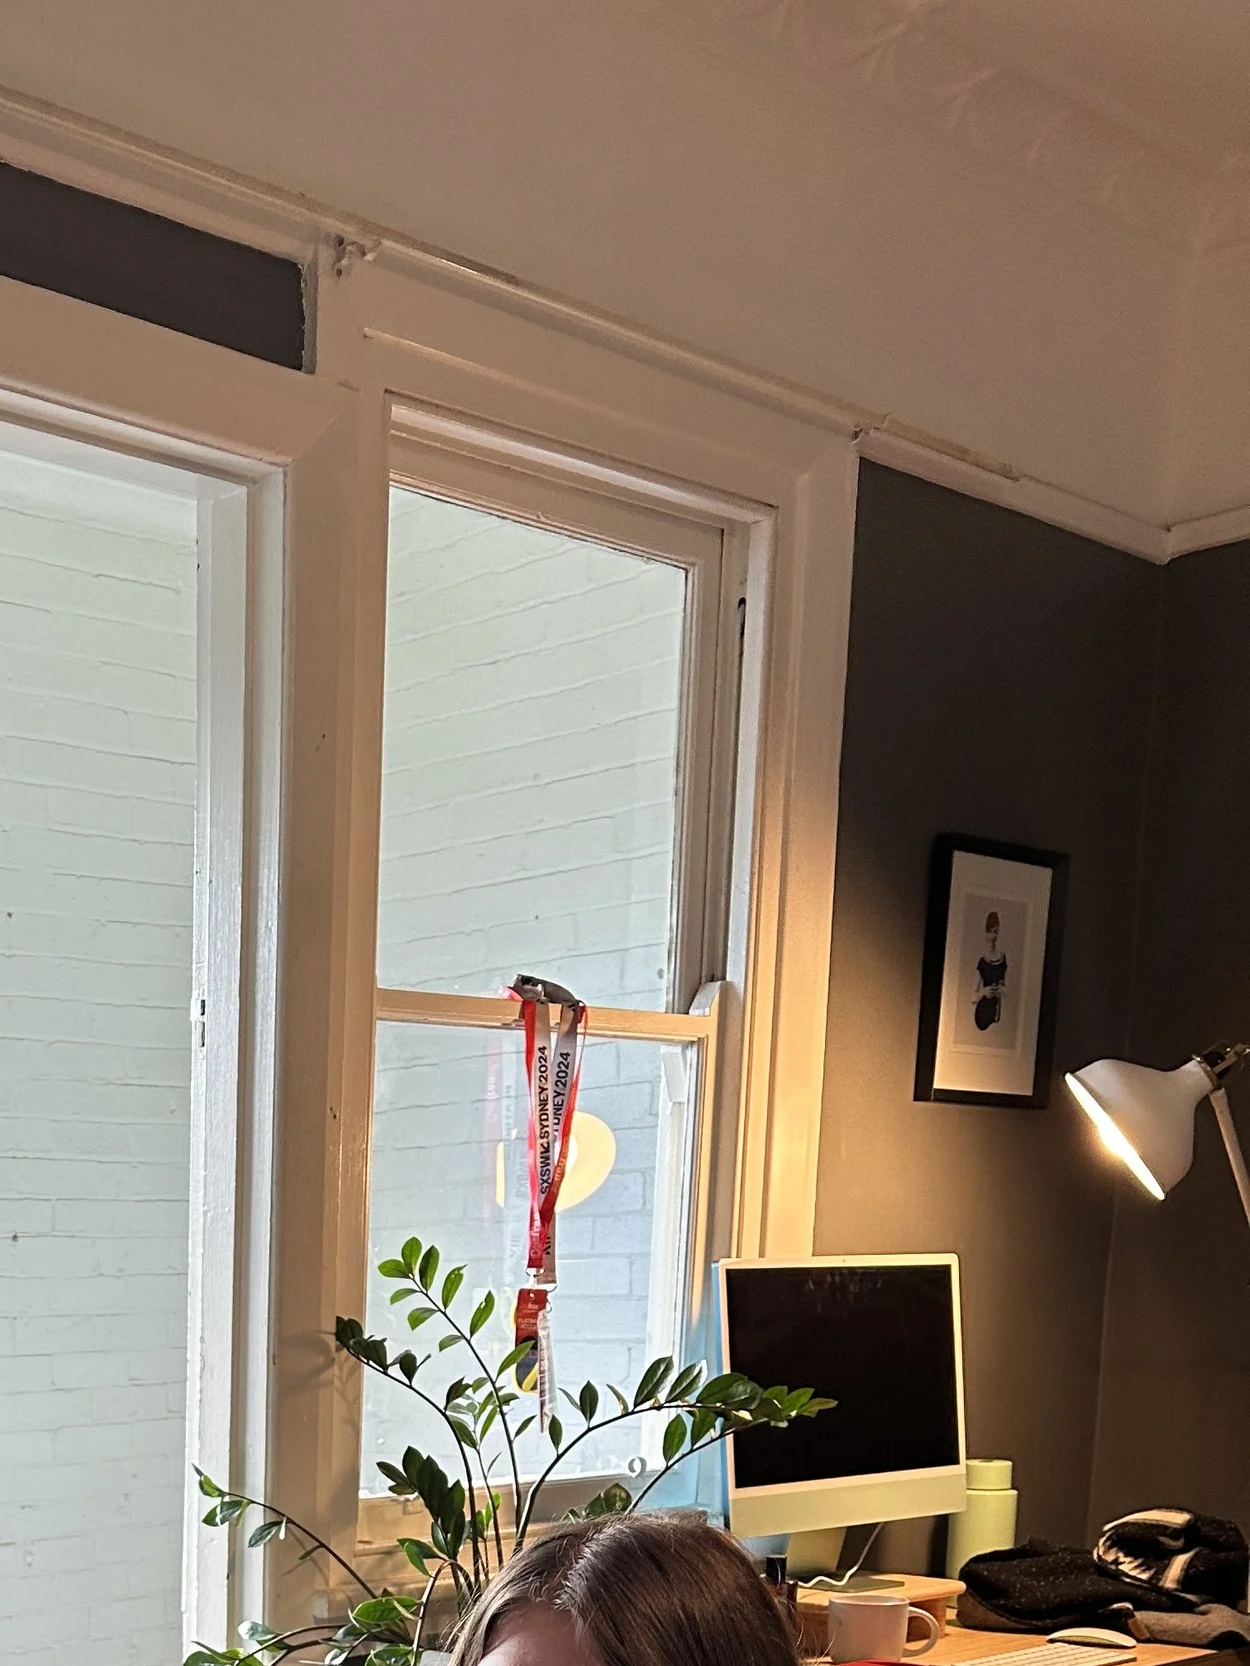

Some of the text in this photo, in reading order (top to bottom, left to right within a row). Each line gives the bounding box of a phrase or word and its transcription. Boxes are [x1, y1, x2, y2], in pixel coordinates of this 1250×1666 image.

[537, 1046, 548, 1084] 2024
[554, 1051, 571, 1091] 2024
[538, 1086, 550, 1140] SYDNEY
[552, 1090, 566, 1140] DNEY
